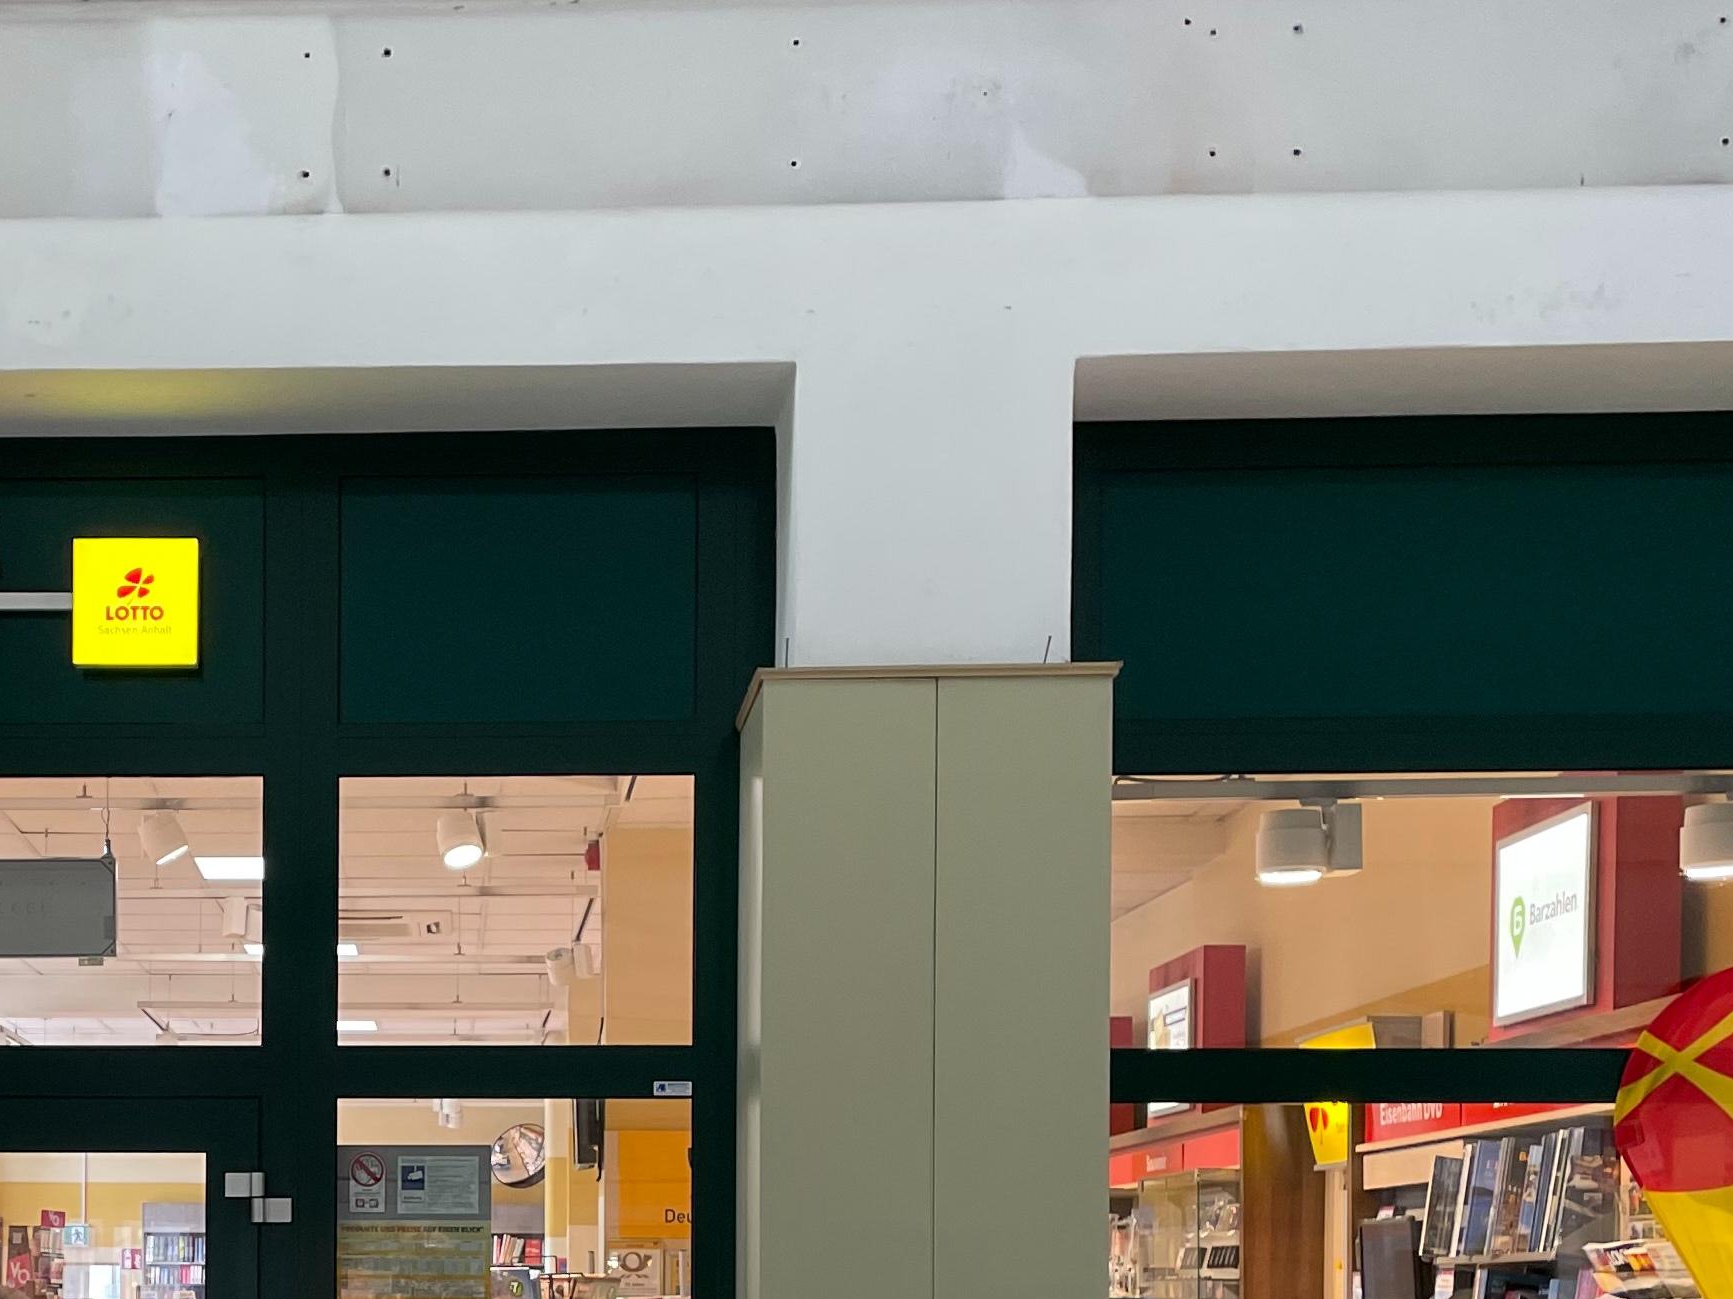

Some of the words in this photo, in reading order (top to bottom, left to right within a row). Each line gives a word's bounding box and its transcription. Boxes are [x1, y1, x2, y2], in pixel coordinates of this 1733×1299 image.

[105, 605, 164, 621] LOTTO
[1530, 891, 1577, 925] Barzahlen
[1379, 1103, 1422, 1125] Eisenbahn
